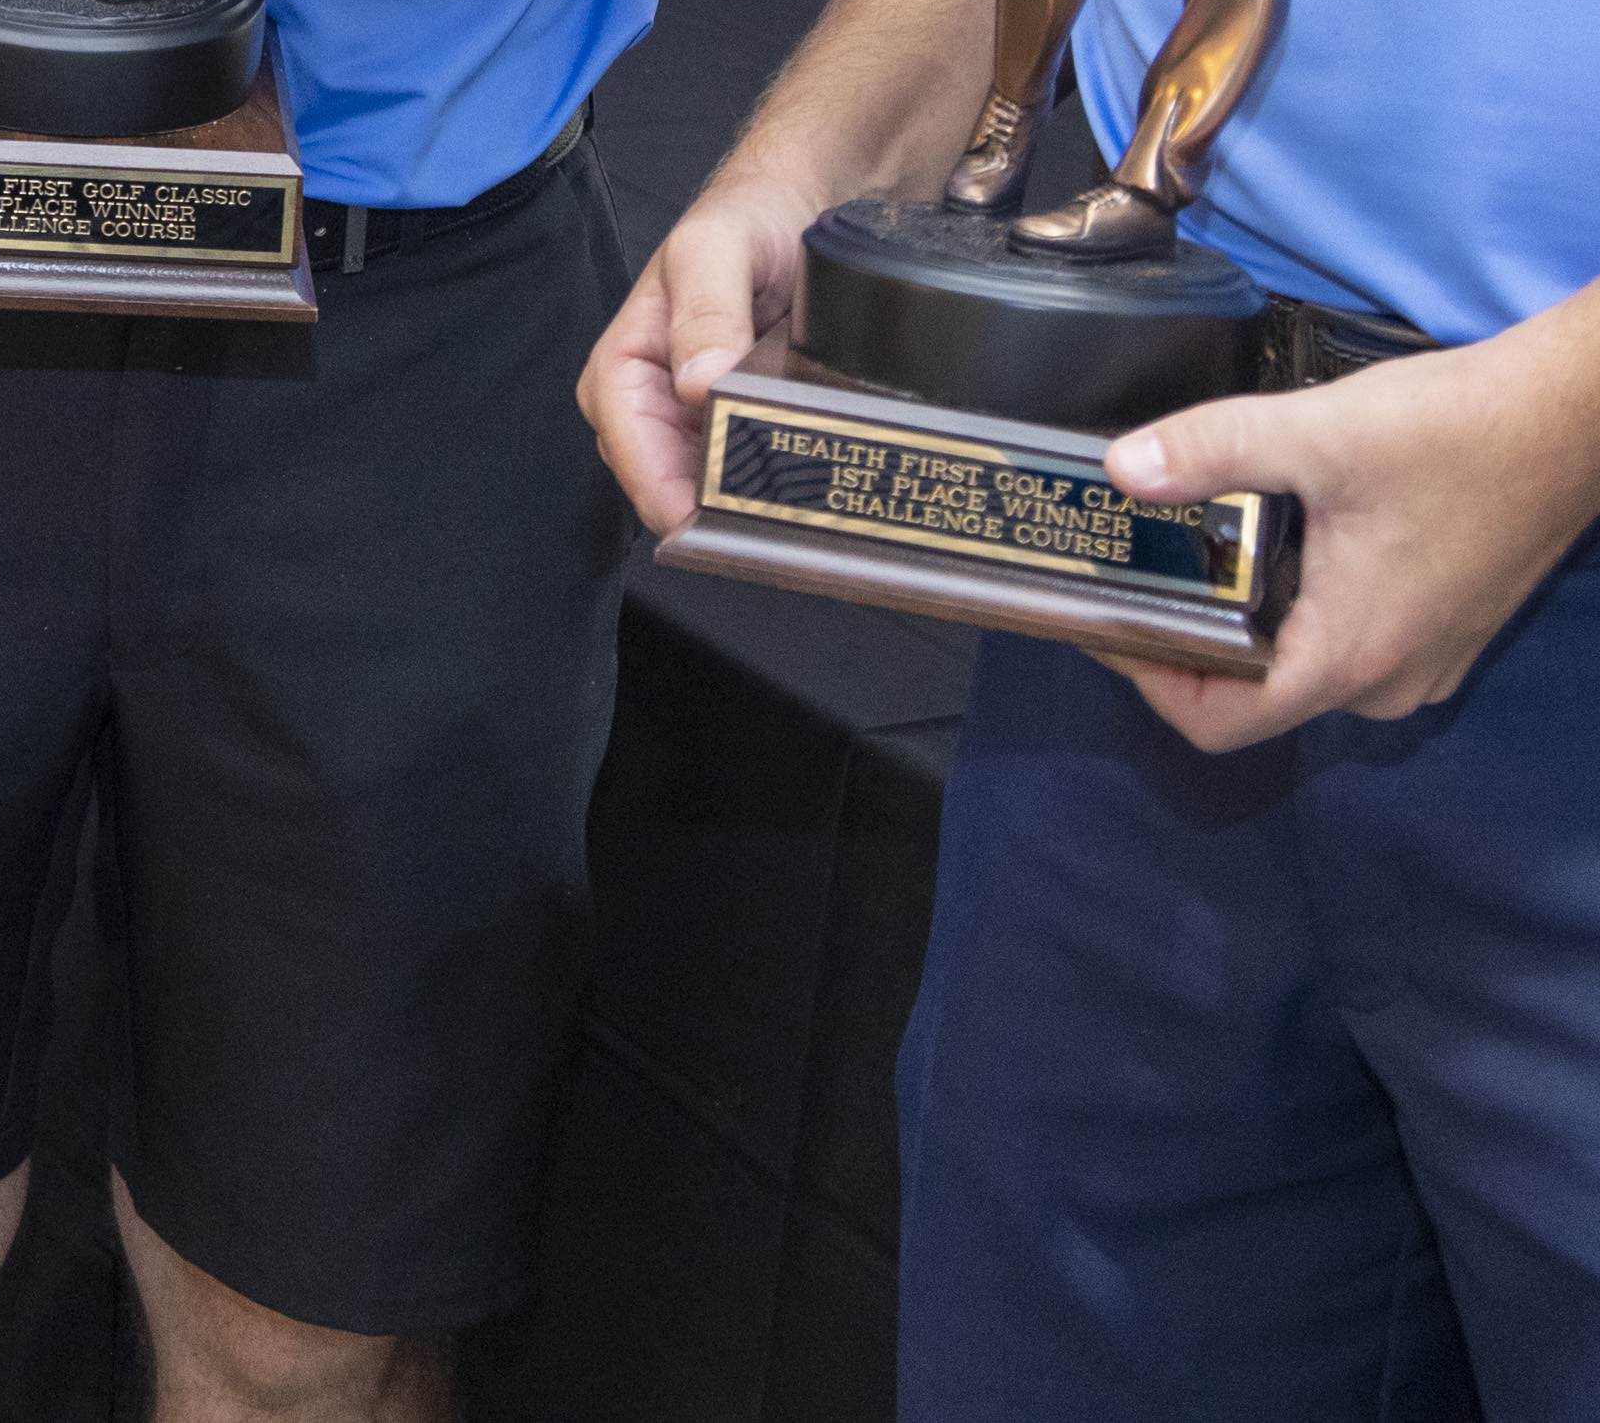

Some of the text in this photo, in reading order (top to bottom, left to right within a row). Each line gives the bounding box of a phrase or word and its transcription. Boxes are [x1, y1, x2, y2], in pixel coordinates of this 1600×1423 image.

[3, 177, 72, 198] FIRST
[82, 182, 146, 203] GOLF
[155, 185, 253, 207] CLASSIC
[88, 201, 197, 223] WINNER
[101, 220, 197, 242] COURSE
[770, 430, 889, 471] HEALTH
[900, 453, 985, 487] FIRST
[995, 470, 1073, 503] GOLF
[827, 490, 1132, 564] CHALLENGE COURSE
[830, 466, 1134, 540] 1ST PLACE WINNER
